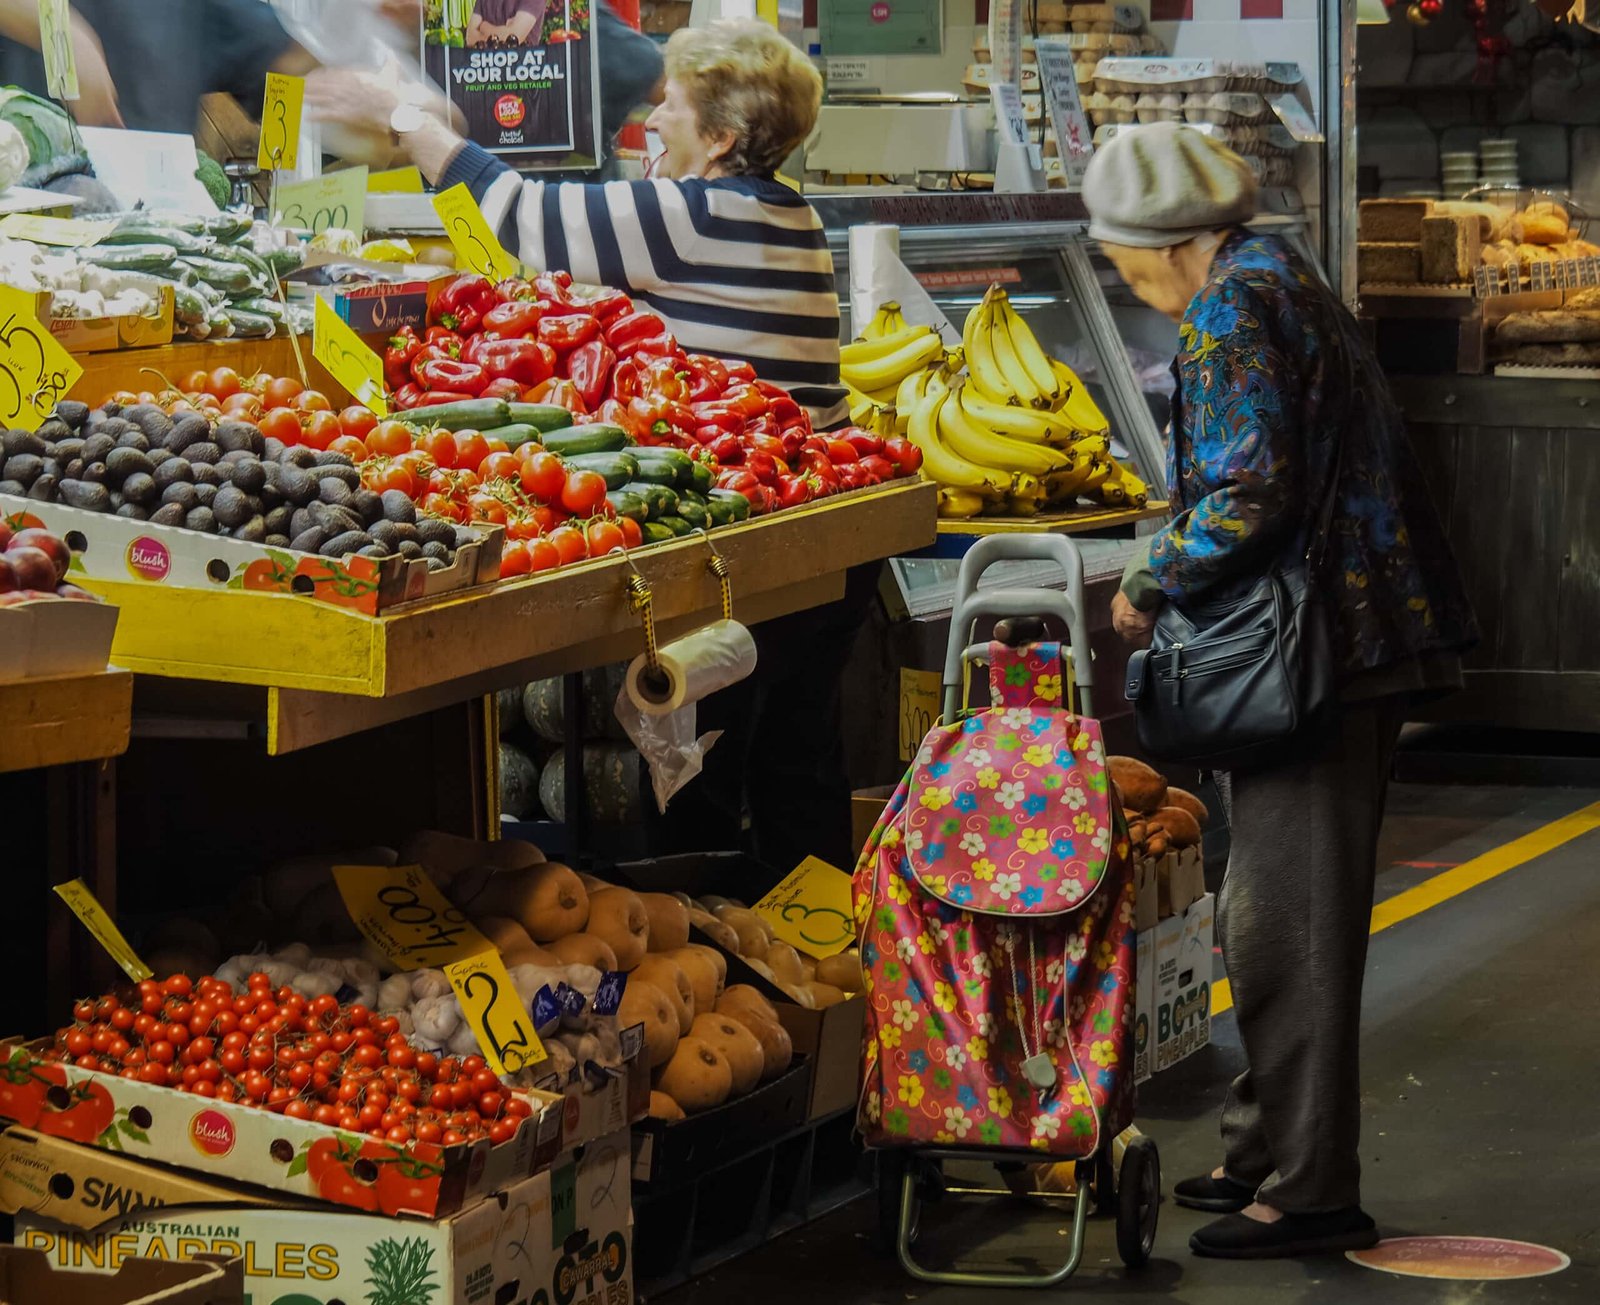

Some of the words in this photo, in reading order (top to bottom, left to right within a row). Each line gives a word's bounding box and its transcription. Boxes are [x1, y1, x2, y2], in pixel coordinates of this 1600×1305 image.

[470, 51, 519, 68] SHOP
[522, 50, 546, 66] AT
[452, 67, 502, 84] YOUR
[505, 64, 565, 81] LOCAL
[465, 84, 485, 92] FRUIT
[519, 81, 552, 89] RETAILER
[131, 547, 167, 569] blush
[781, 903, 852, 945] 3
[1157, 981, 1209, 1045] BOTO
[195, 1119, 230, 1142] blush
[120, 1221, 241, 1238] AUSTRALIAN
